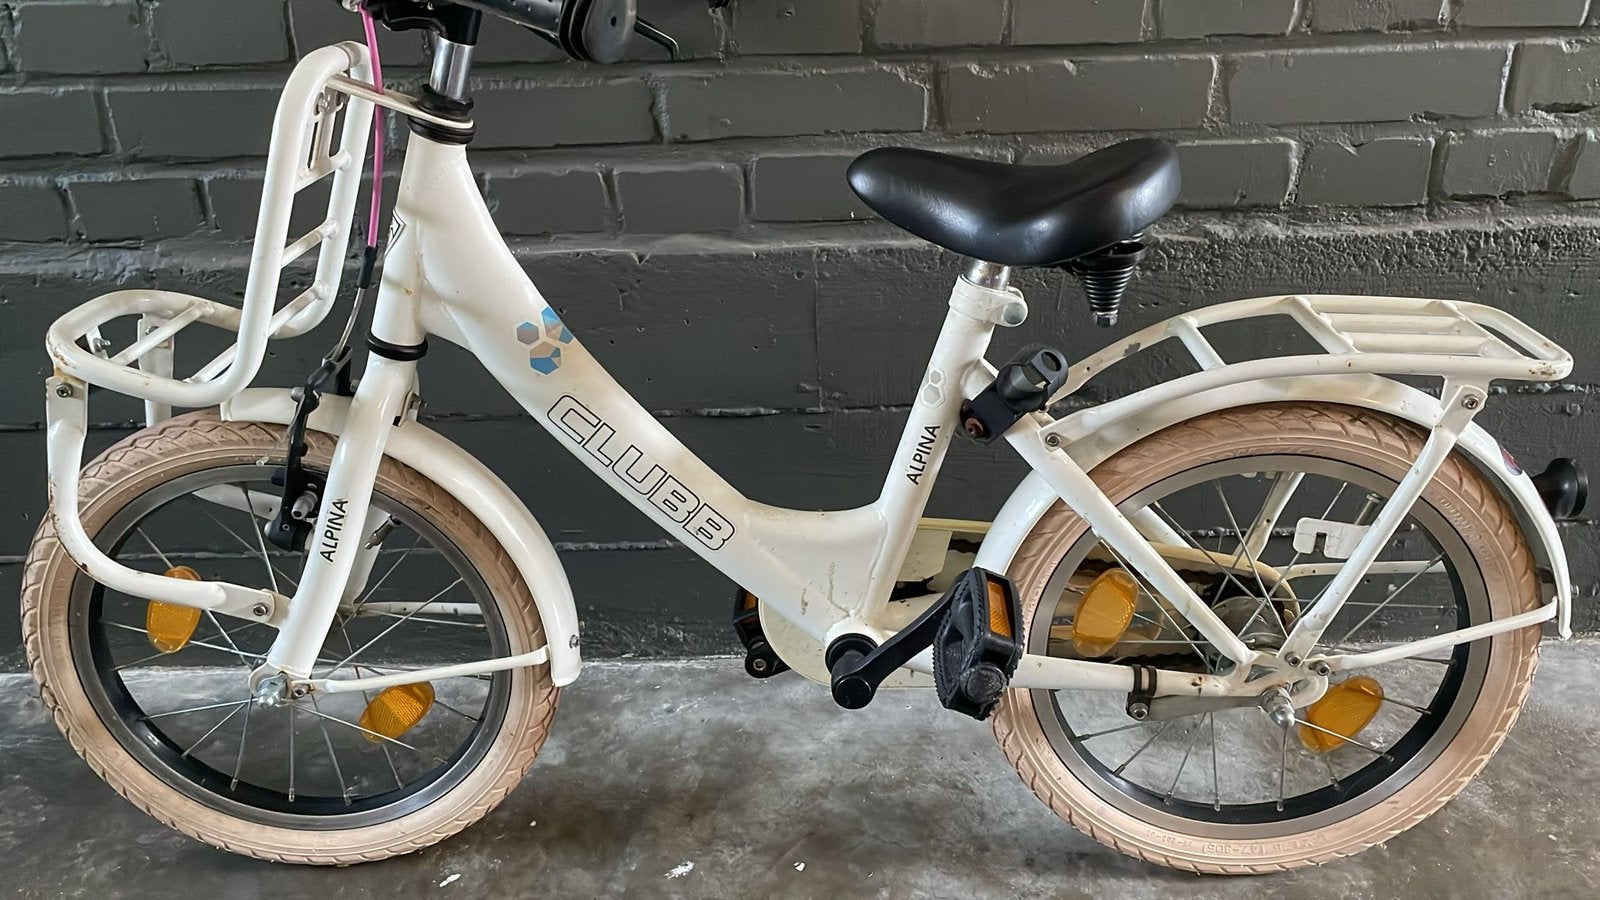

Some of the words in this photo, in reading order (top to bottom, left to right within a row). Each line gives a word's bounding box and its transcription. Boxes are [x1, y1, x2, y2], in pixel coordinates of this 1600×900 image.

[546, 394, 736, 551] CLUBB
[905, 425, 941, 486] ALPINA
[319, 500, 349, 563] ALPINA
